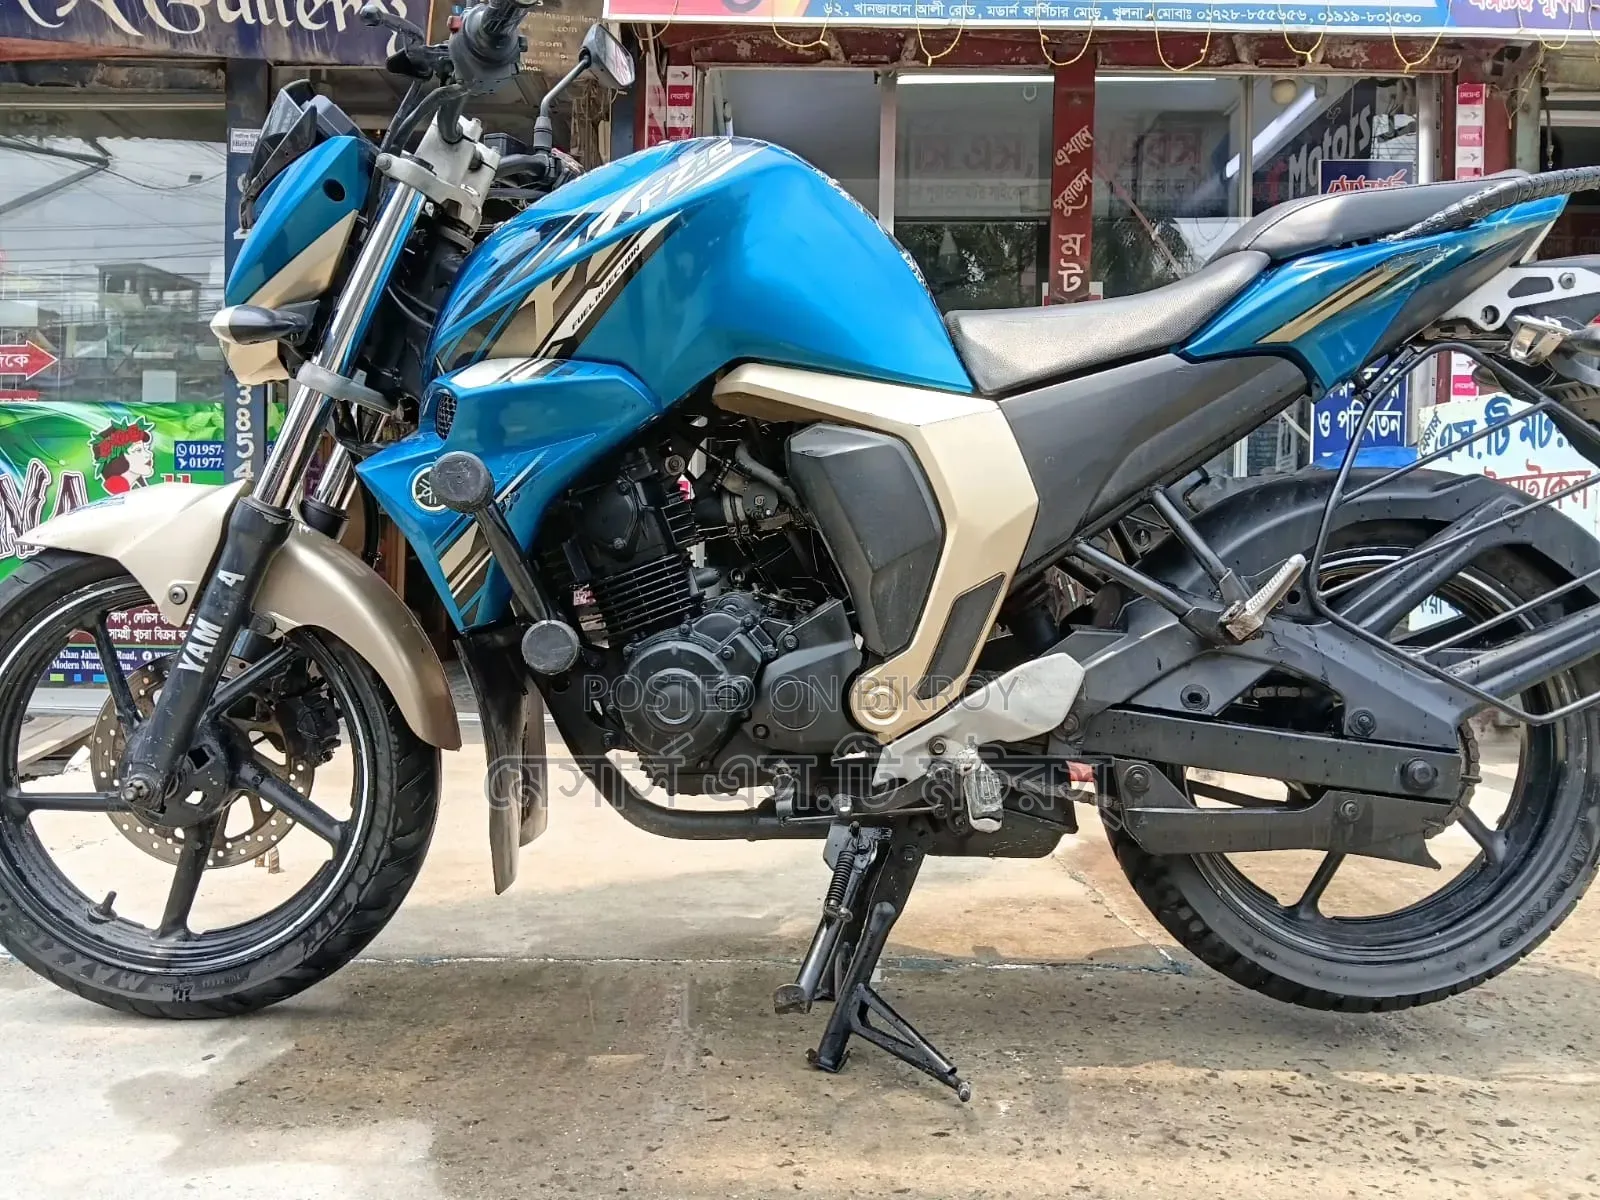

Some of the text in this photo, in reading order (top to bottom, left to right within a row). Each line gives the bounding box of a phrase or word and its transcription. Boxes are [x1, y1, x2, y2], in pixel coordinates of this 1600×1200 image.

[854, 3, 912, 16] খানজাহান
[916, 1, 945, 16] আলী
[1054, 125, 1094, 166] এখানে
[1288, 104, 1372, 200] Motors
[1053, 168, 1094, 217] পুরাতন
[571, 243, 641, 331] FUEL INJECTION
[80, 650, 100, 660] Jaha
